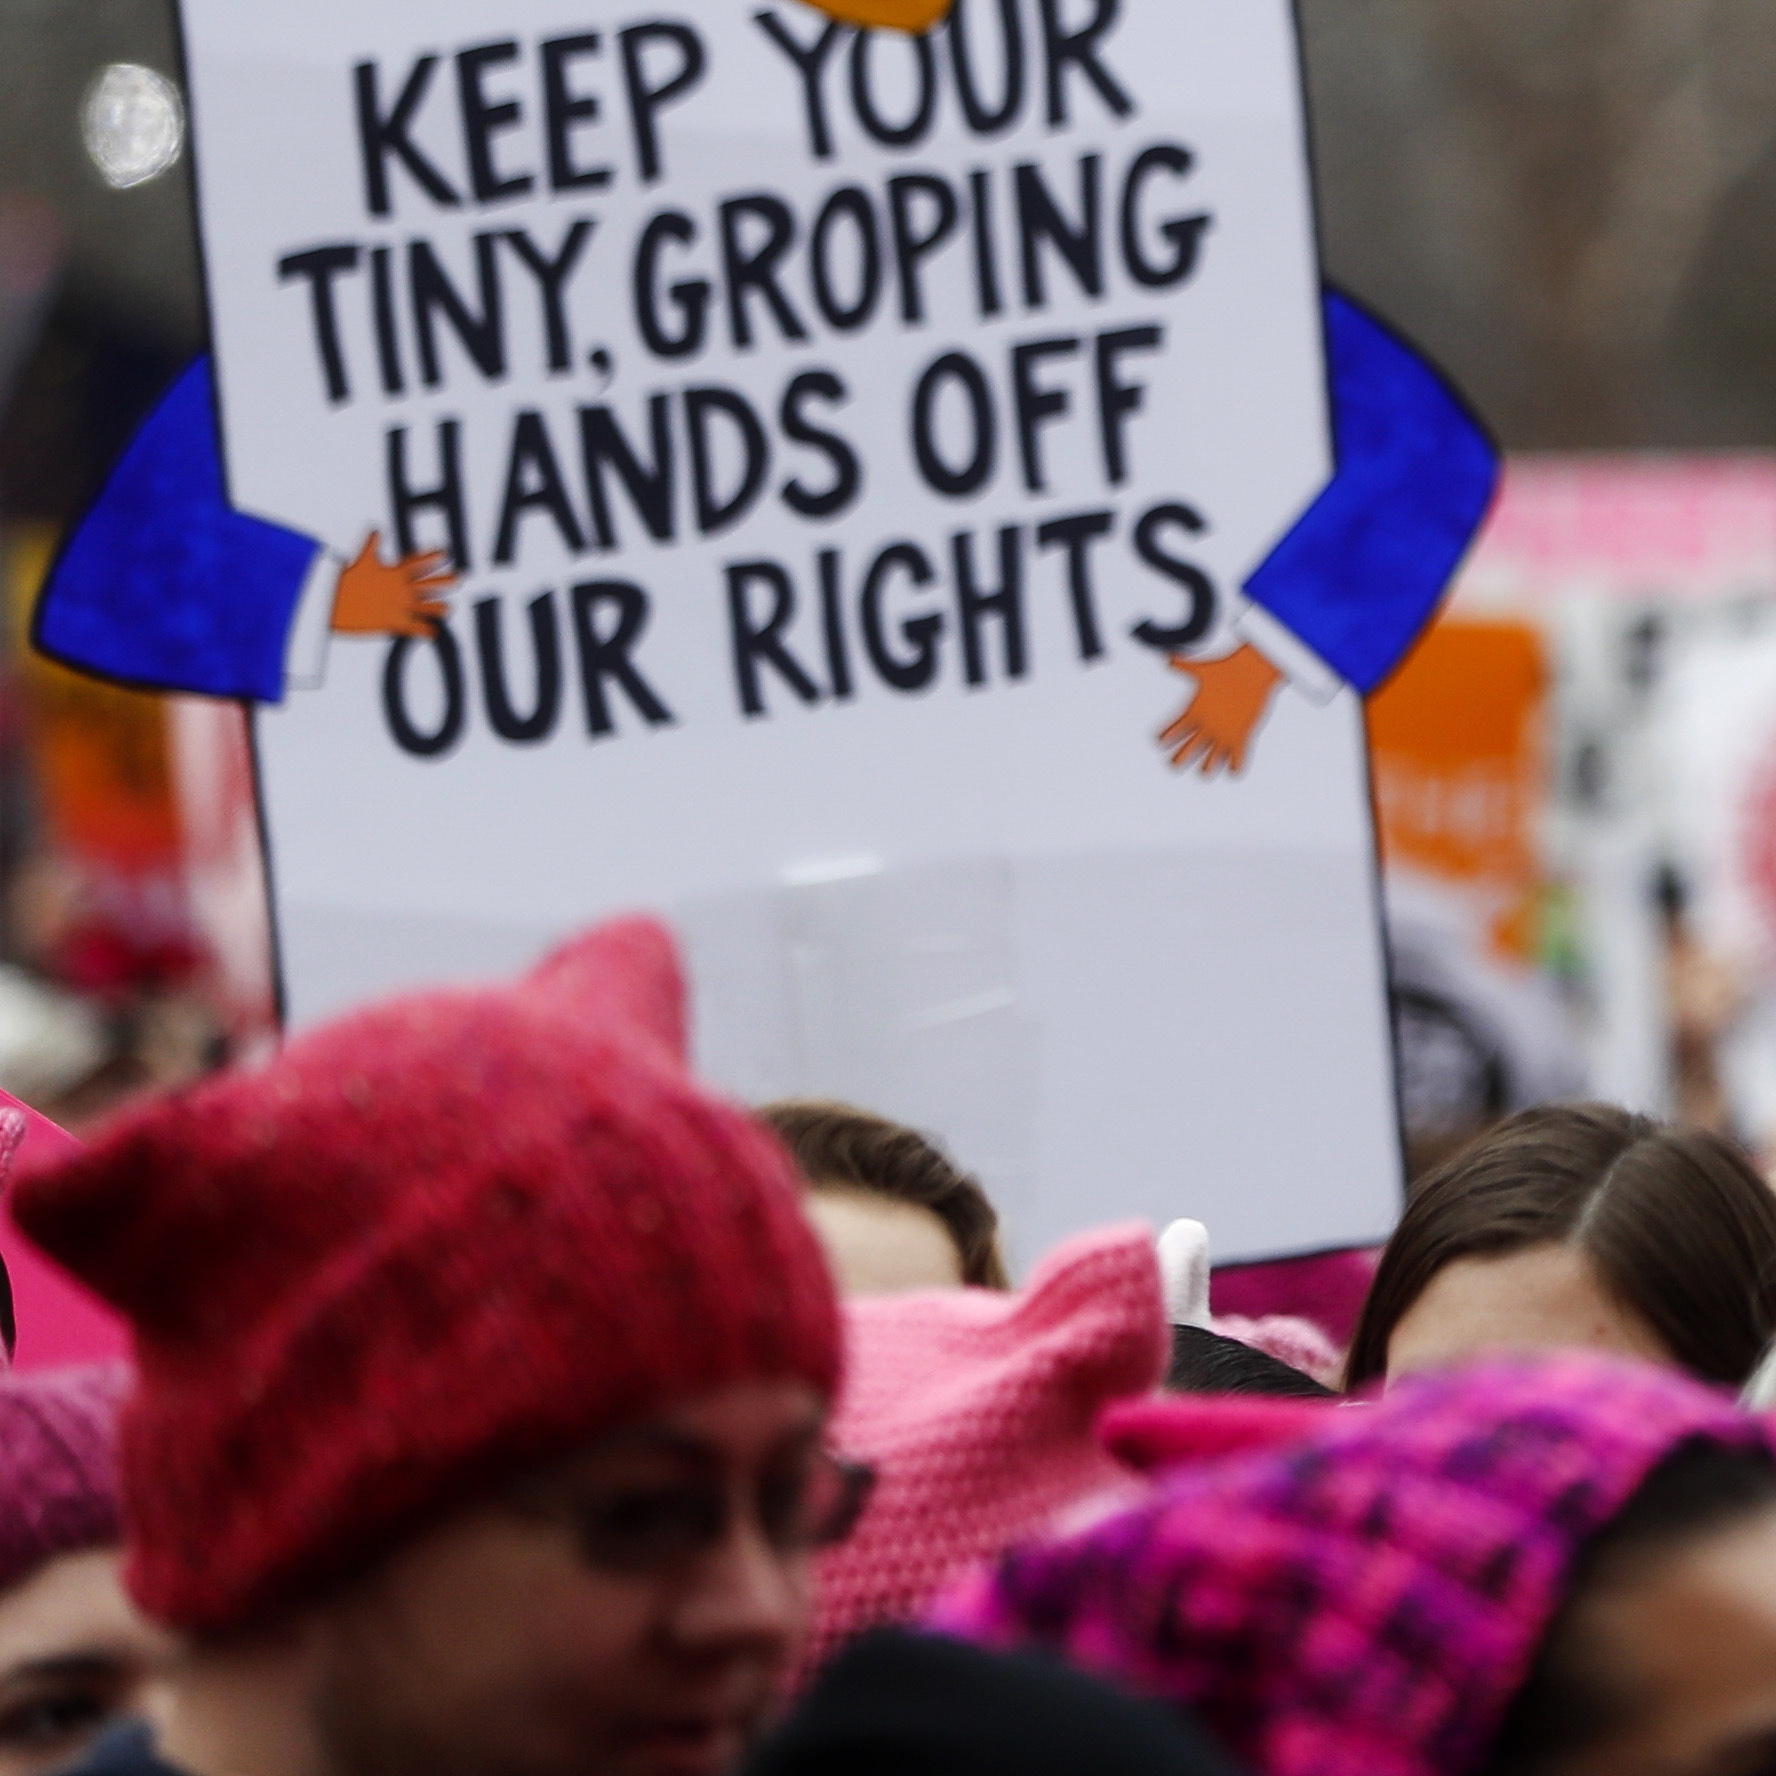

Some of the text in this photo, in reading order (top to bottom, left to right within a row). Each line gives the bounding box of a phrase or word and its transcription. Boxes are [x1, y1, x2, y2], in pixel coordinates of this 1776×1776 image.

[352, 21, 706, 217] KEEP
[633, 144, 1212, 360] GROPING
[387, 325, 1164, 576] HANDS OFF
[381, 502, 1216, 758] OUR RIGHTS
